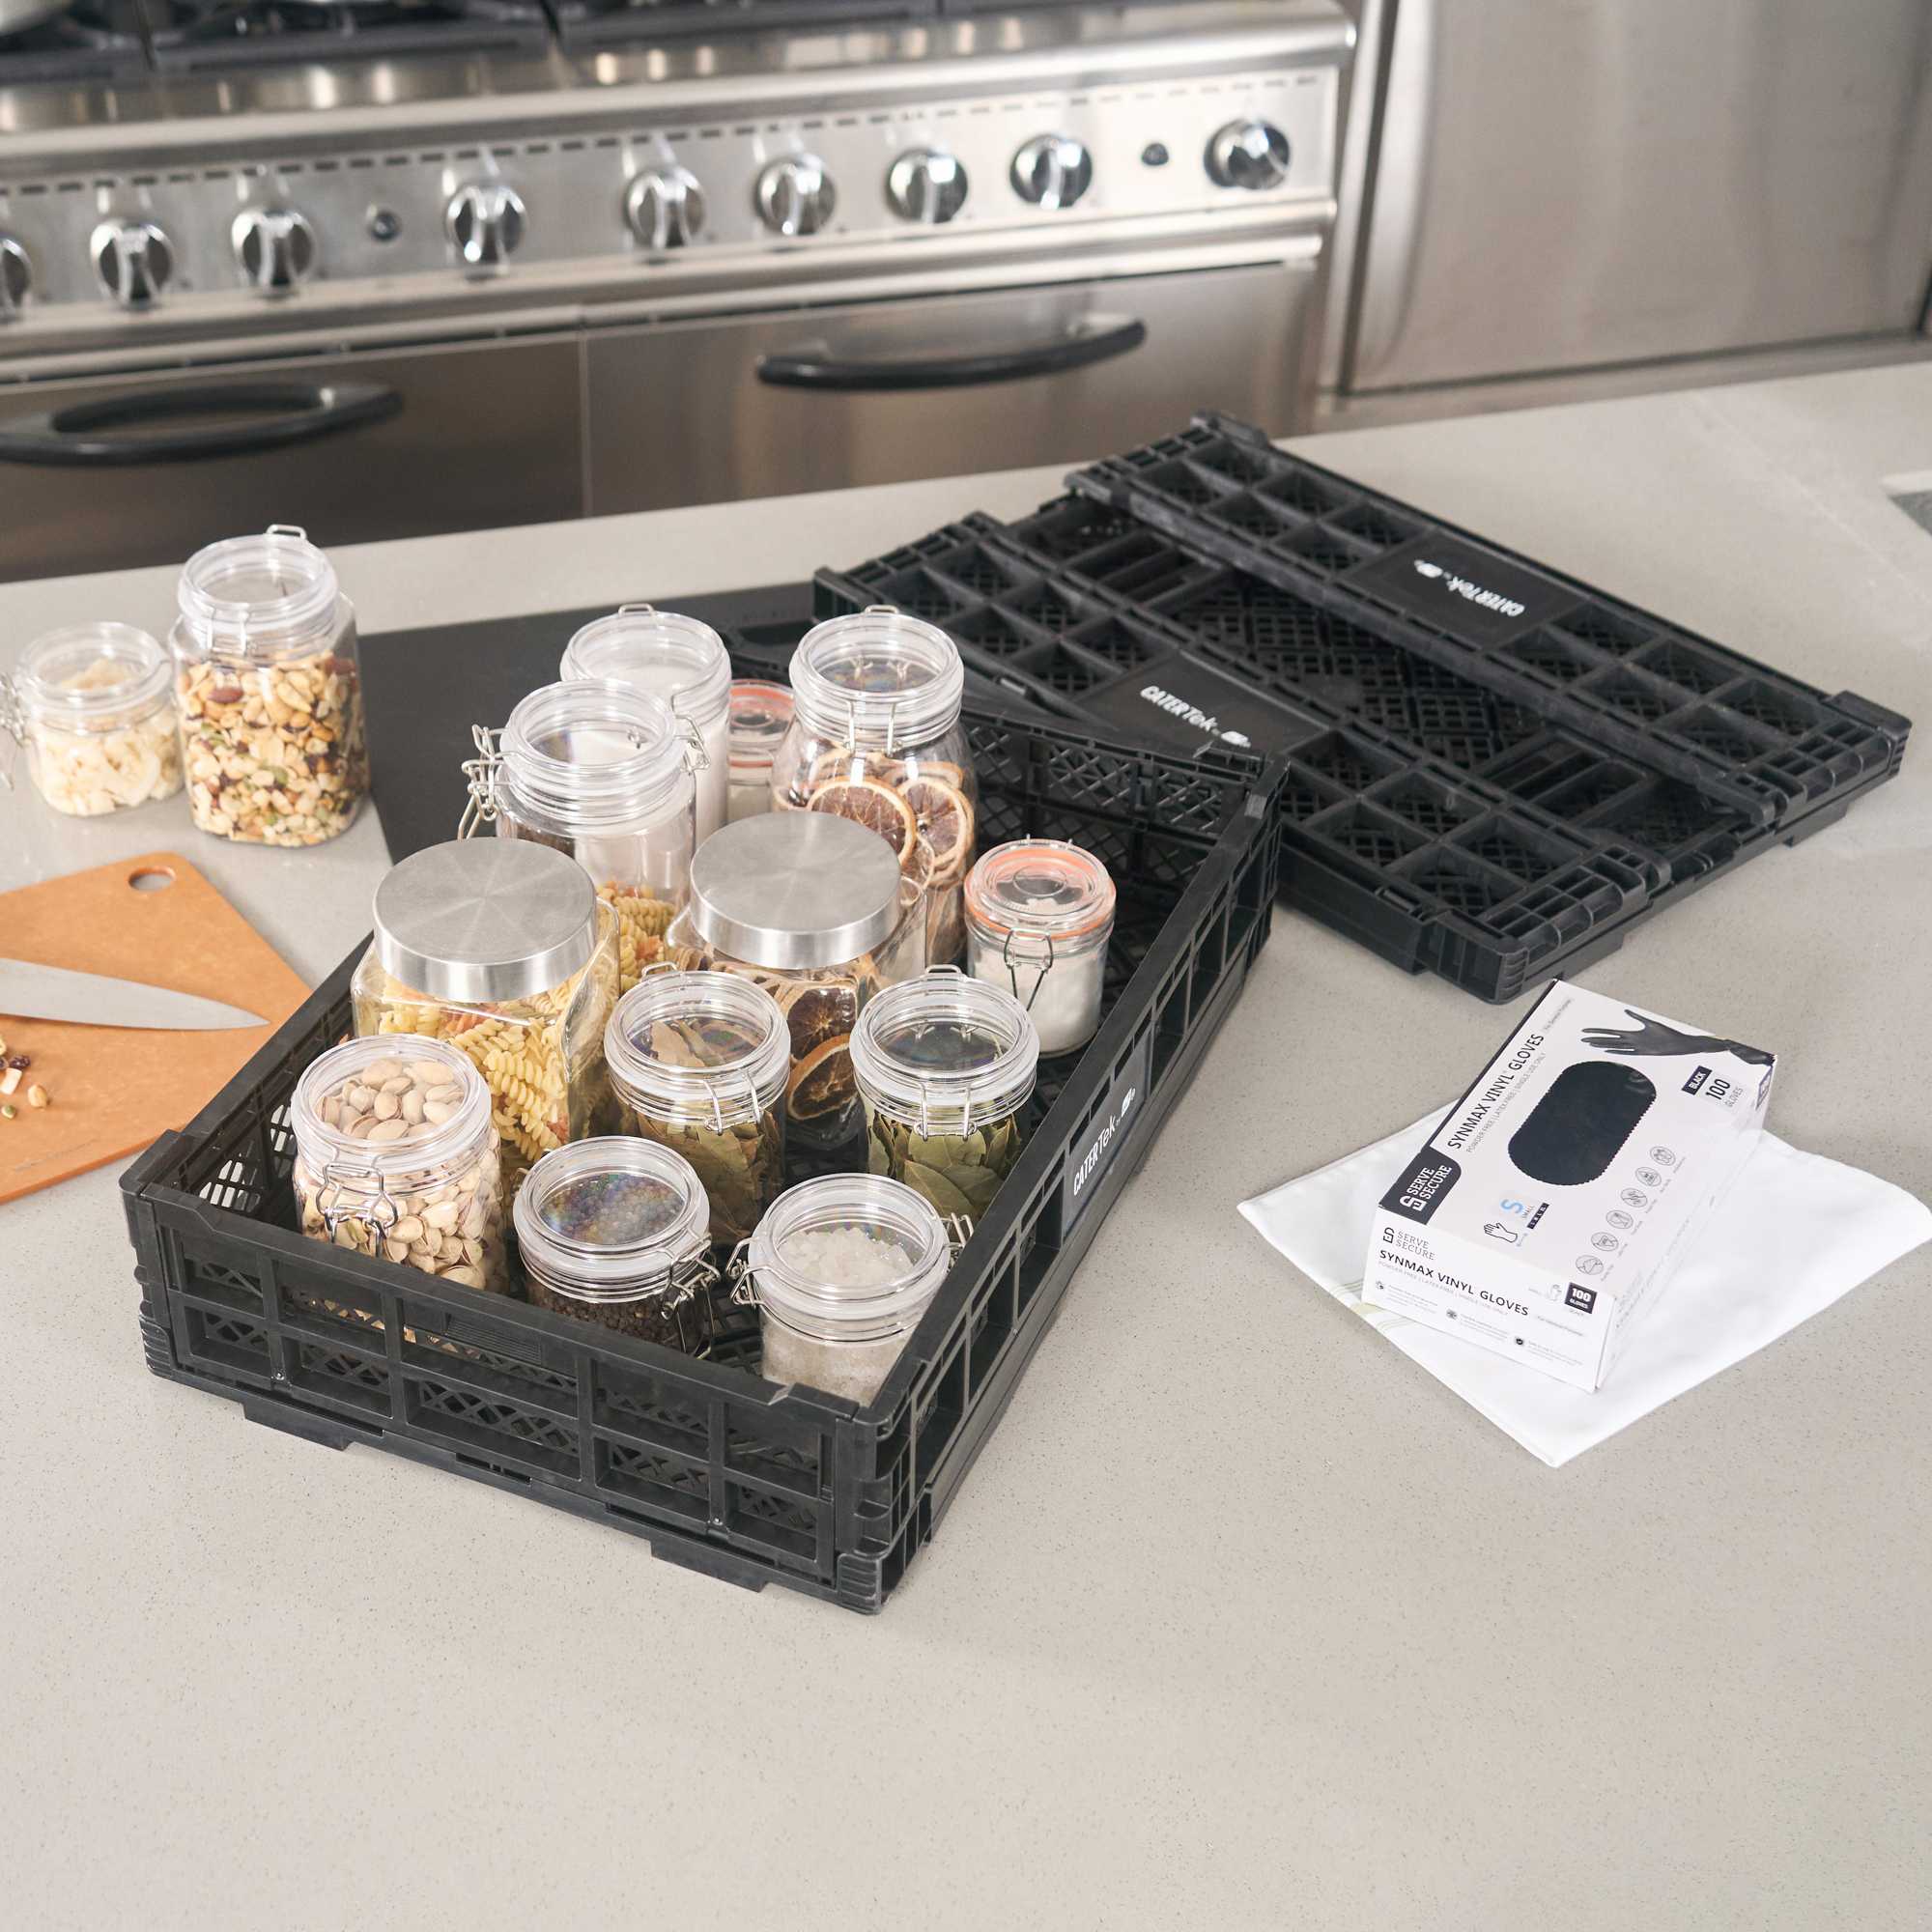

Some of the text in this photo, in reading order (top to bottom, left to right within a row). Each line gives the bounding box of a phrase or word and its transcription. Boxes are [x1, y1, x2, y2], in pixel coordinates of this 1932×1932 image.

[1447, 1034, 1545, 1149] SYNMAX VINYL GLOVES
[1705, 1078, 1731, 1100] 100
[1406, 1167, 1435, 1196] SERVE
[1419, 1164, 1453, 1201] SECURE
[1500, 1199, 1524, 1215] S
[1395, 1240, 1436, 1261] SECURE
[1397, 1231, 1430, 1250] SERVE
[1379, 1249, 1435, 1278] SYNMAX
[1437, 1272, 1474, 1295] VINYL
[1479, 1291, 1529, 1316] GLOVES
[1572, 1288, 1592, 1302] 100
